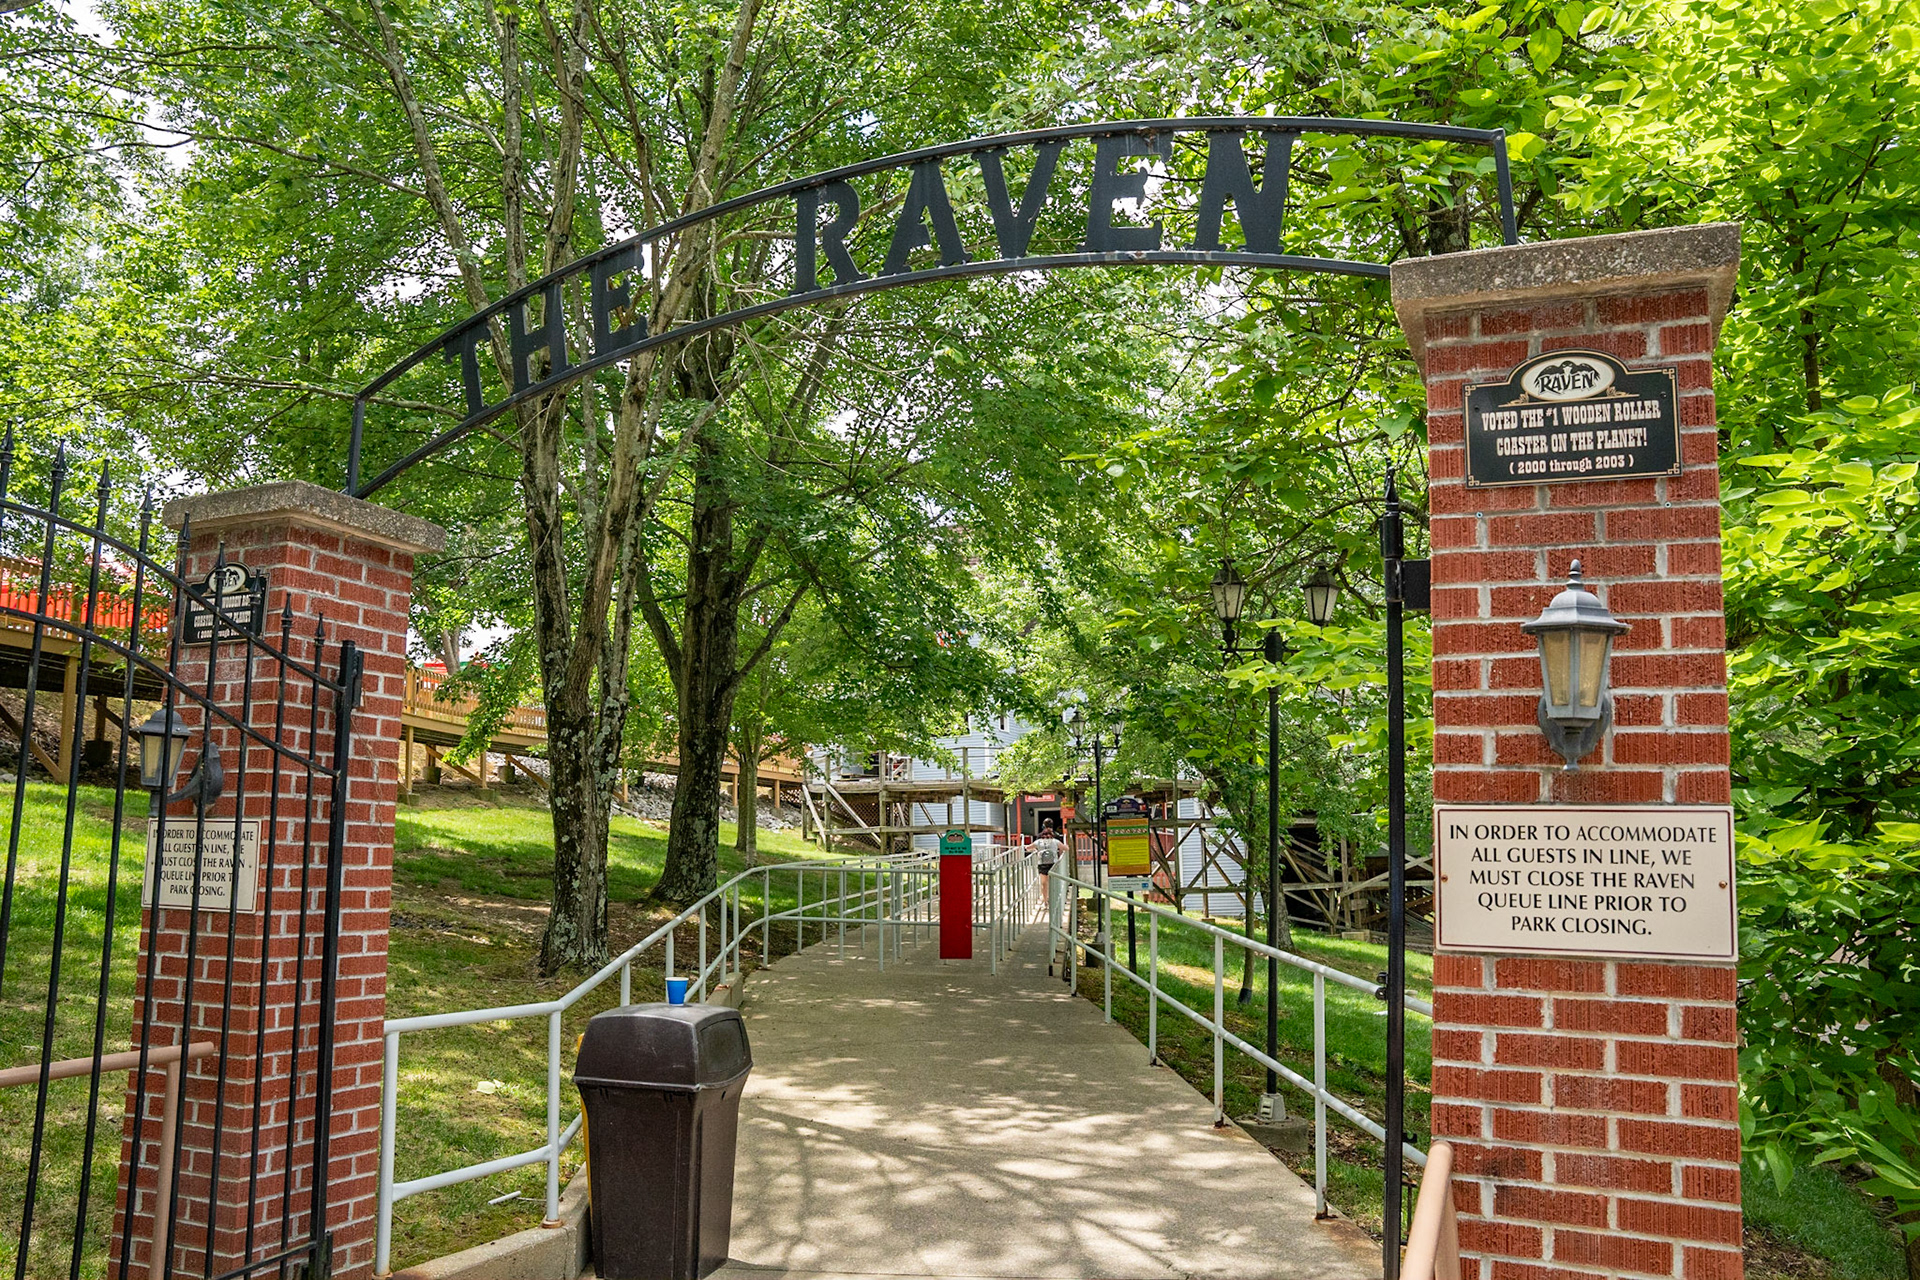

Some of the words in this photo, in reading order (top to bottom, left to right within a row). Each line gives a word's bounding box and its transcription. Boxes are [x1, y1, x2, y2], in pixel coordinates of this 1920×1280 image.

[444, 241, 648, 418] THE
[787, 129, 1299, 296] RAVEN
[1538, 371, 1595, 394] RAVEN
[1481, 410, 1518, 430] VOTED
[1520, 408, 1544, 428] THE
[1546, 407, 1559, 426] #1
[1562, 403, 1612, 425] WOODEN
[1614, 400, 1661, 422] ROLLER
[1496, 434, 1548, 456] COASTER
[1551, 433, 1568, 452] ON
[1570, 431, 1594, 451] THE
[1596, 427, 1648, 449] PLANET!
[1518, 460, 1547, 474] 2000
[1550, 457, 1592, 472] through
[1596, 455, 1625, 469] 2003
[163, 830, 183, 839] ORDER
[186, 830, 195, 839] TO
[1450, 824, 1469, 840] IN
[1474, 824, 1538, 841] ORDER
[1544, 825, 1570, 841] TO
[1576, 826, 1717, 843] ACCOMMODATE
[174, 843, 196, 853] GUEST
[211, 844, 230, 856] LINE,
[232, 845, 245, 854] E
[1471, 847, 1501, 863] ALL
[1507, 848, 1576, 864] GUESTS
[1583, 849, 1603, 864] IN
[1609, 849, 1656, 868] LINE,
[1661, 850, 1692, 866] WE
[203, 858, 217, 868] THE
[219, 858, 245, 868] RAVN
[161, 871, 183, 882] QUEUE
[202, 872, 226, 882] PRIOR
[1469, 870, 1521, 886] MUST
[1528, 870, 1584, 887] CLOSE
[1590, 872, 1628, 888] THE
[1634, 872, 1695, 889] RAVEN
[170, 885, 188, 894] PARK
[190, 885, 225, 896] COSING.
[1478, 892, 1542, 911] QUEUE
[1548, 894, 1587, 910] LINE
[1594, 895, 1652, 912] PRIOR
[1658, 896, 1687, 912] TO
[1511, 916, 1556, 932] PARK
[1562, 917, 1652, 935] CLOSING.
